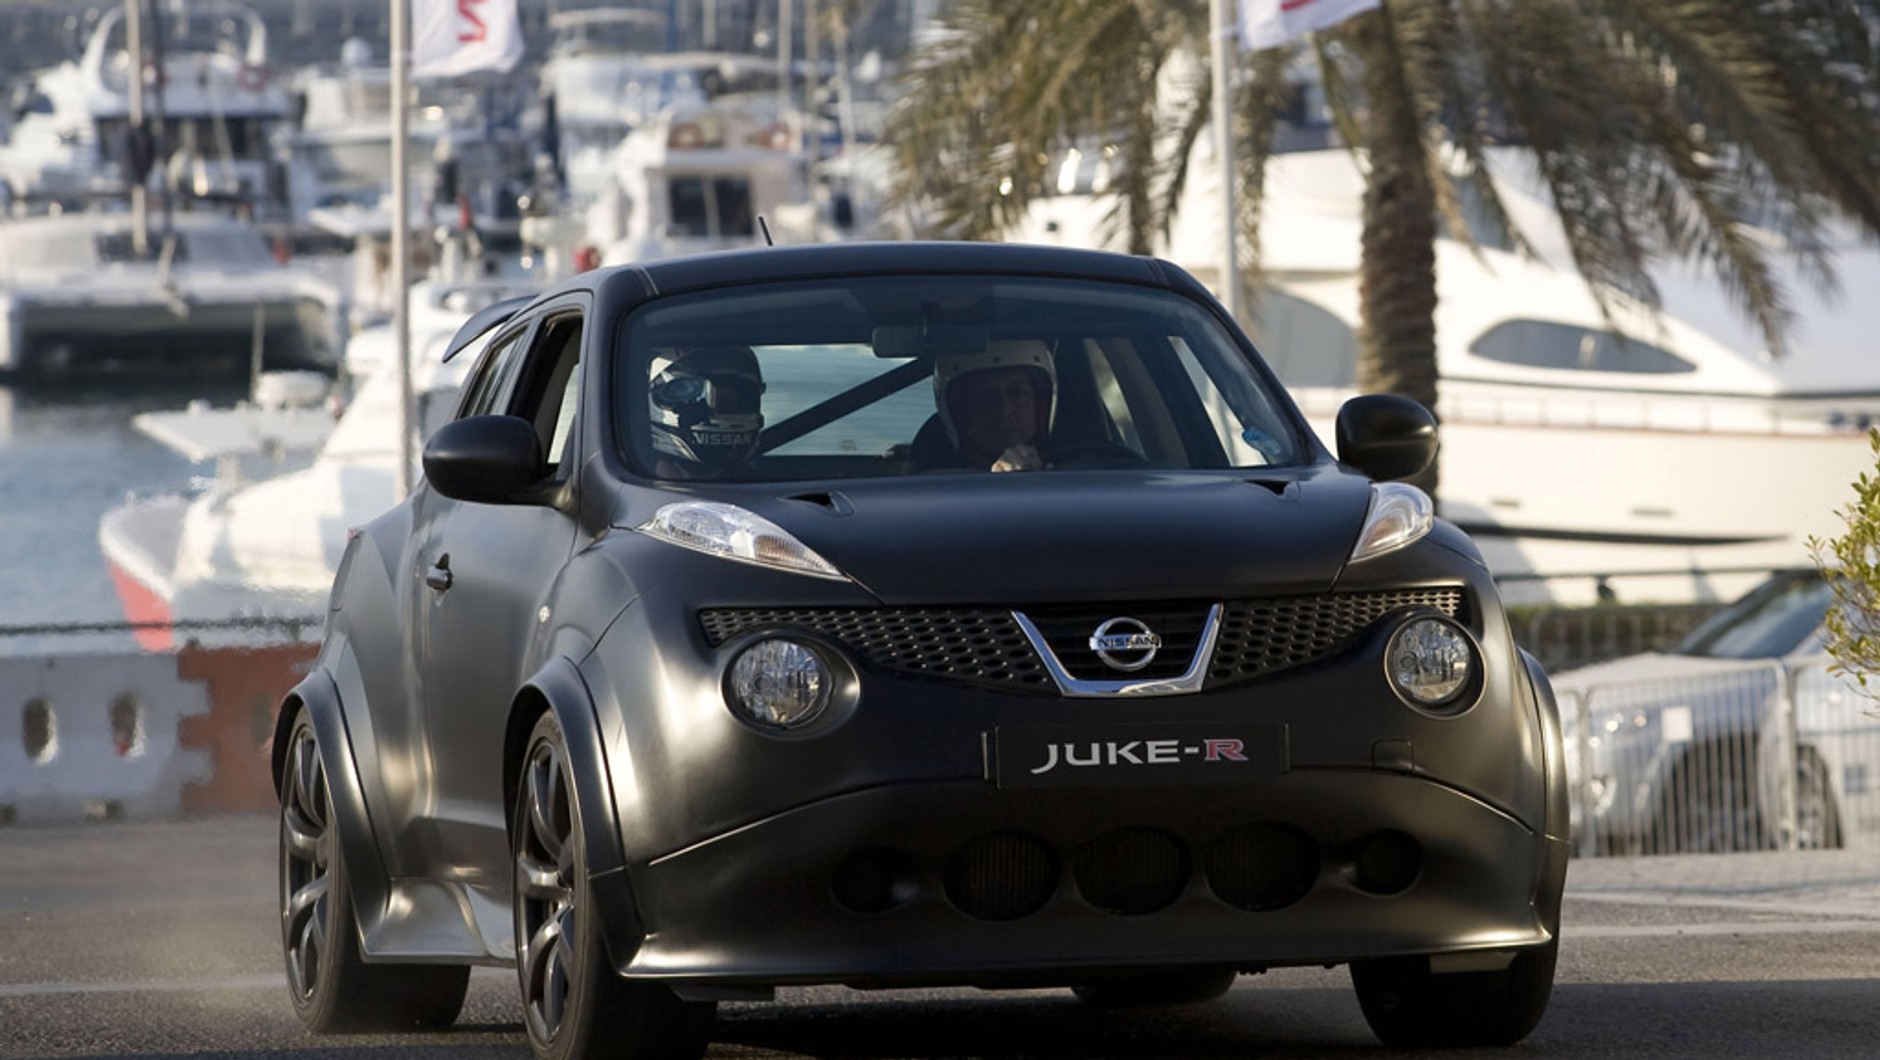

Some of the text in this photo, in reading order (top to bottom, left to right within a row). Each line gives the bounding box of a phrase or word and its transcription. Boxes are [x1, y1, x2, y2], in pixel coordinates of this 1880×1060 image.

[691, 431, 752, 445] NISSAN
[1097, 635, 1157, 649] NISSAN
[1030, 739, 1249, 774] JUKE-R
